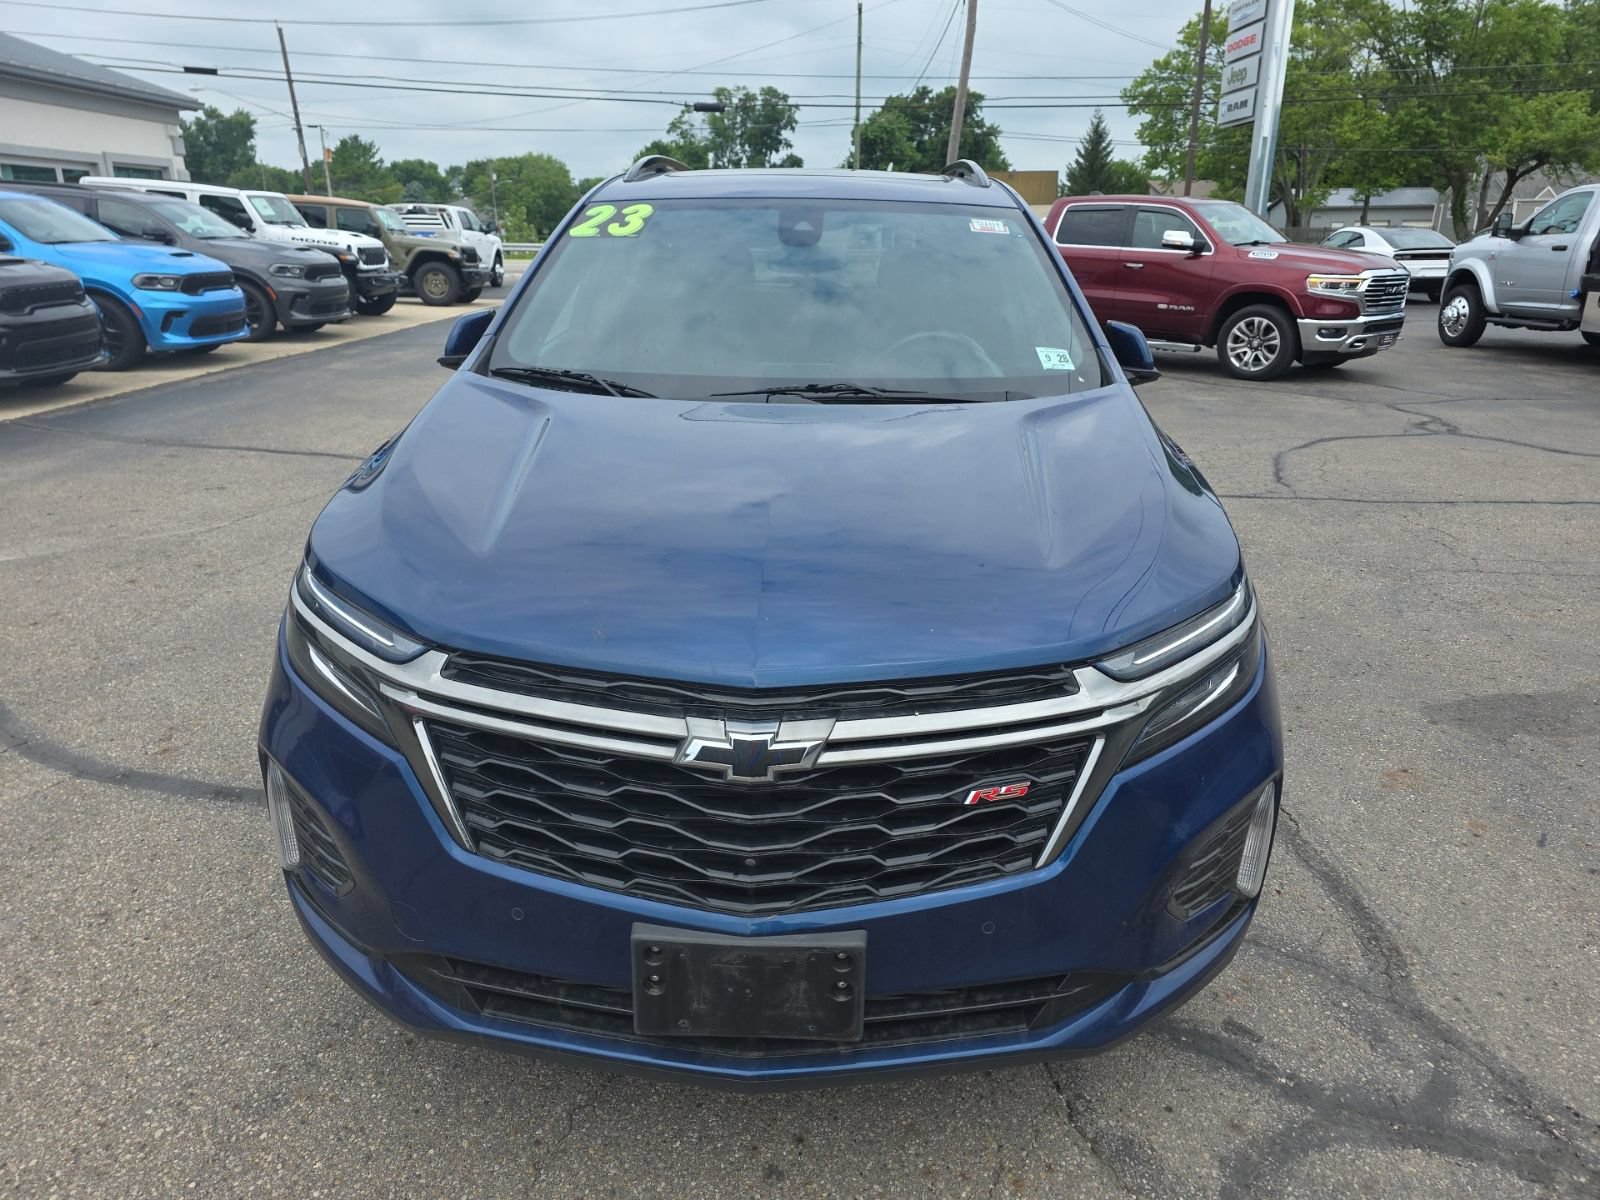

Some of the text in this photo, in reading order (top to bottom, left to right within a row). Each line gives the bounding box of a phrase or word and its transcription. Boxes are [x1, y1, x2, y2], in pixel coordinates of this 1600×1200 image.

[1227, 33, 1257, 53] DODGE
[1227, 66, 1248, 86] Jeep
[1227, 99, 1249, 113] RAM
[569, 203, 655, 238] 23
[1168, 304, 1195, 312] RAM
[1044, 353, 1069, 363] 9 28
[964, 780, 1031, 805] RS
